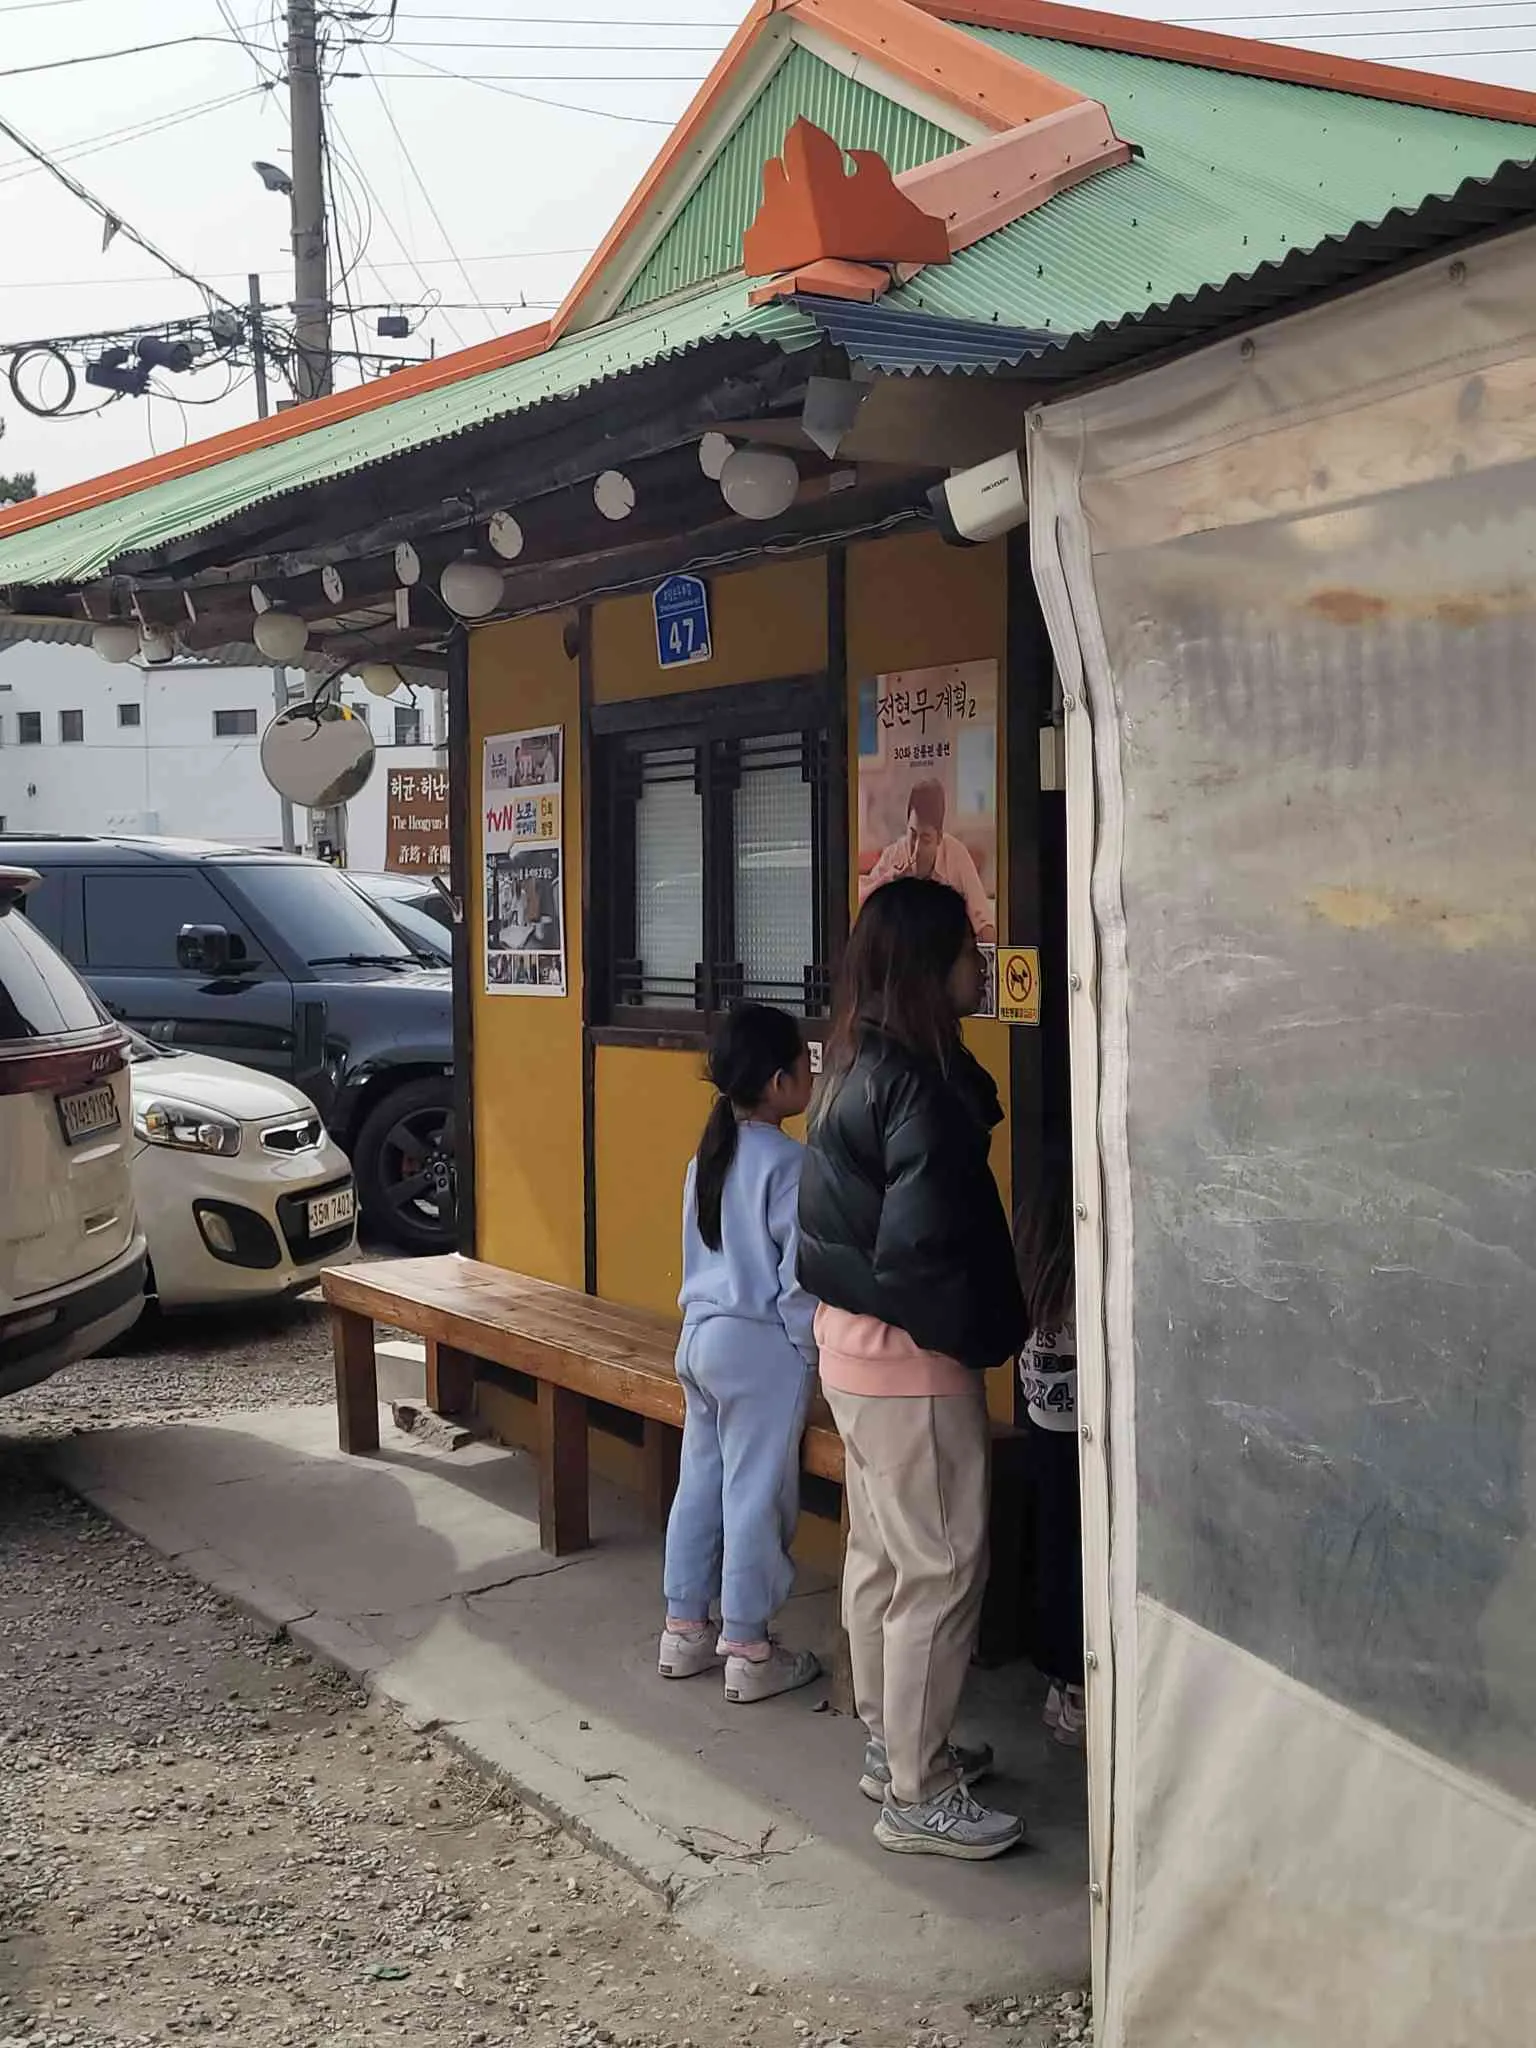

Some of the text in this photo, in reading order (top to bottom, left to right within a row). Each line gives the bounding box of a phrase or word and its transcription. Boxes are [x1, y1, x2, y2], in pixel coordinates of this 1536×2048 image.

[669, 618, 694, 655] 47
[894, 745, 912, 760] 30화
[392, 815, 407, 830] The
[487, 804, 513, 832] tvN
